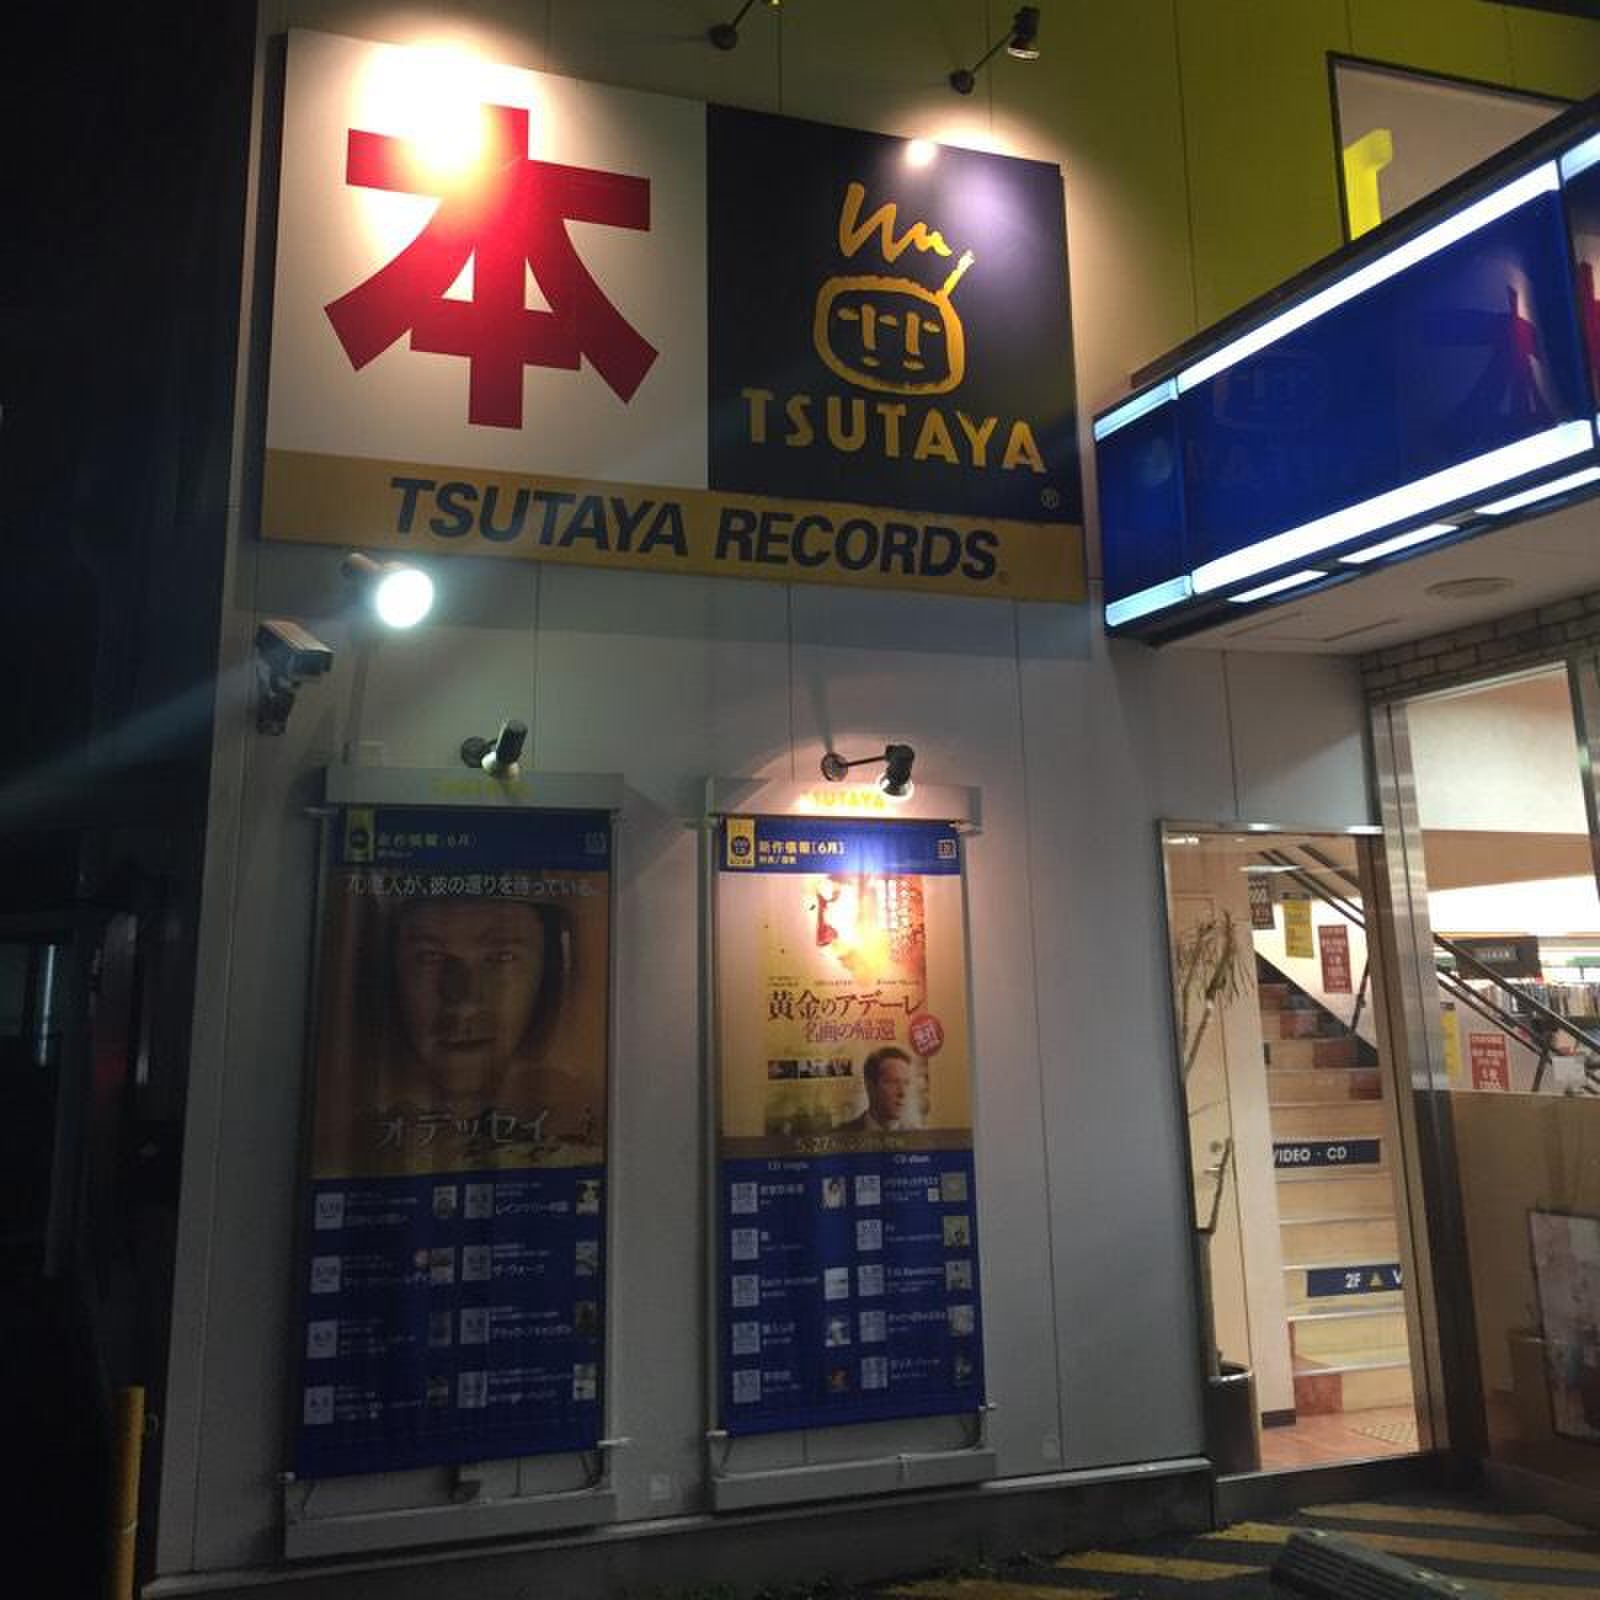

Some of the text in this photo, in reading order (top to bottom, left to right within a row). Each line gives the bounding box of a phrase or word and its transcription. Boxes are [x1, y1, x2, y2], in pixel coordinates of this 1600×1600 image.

[324, 102, 659, 429] 本
[742, 387, 1047, 474] TSUTAYA
[391, 477, 1000, 581] TSUTAYA RECORDS
[767, 989, 923, 1021] 黄金のアデーレ
[1326, 1146, 1348, 1160] CD
[1344, 1272, 1362, 1289] 2F
